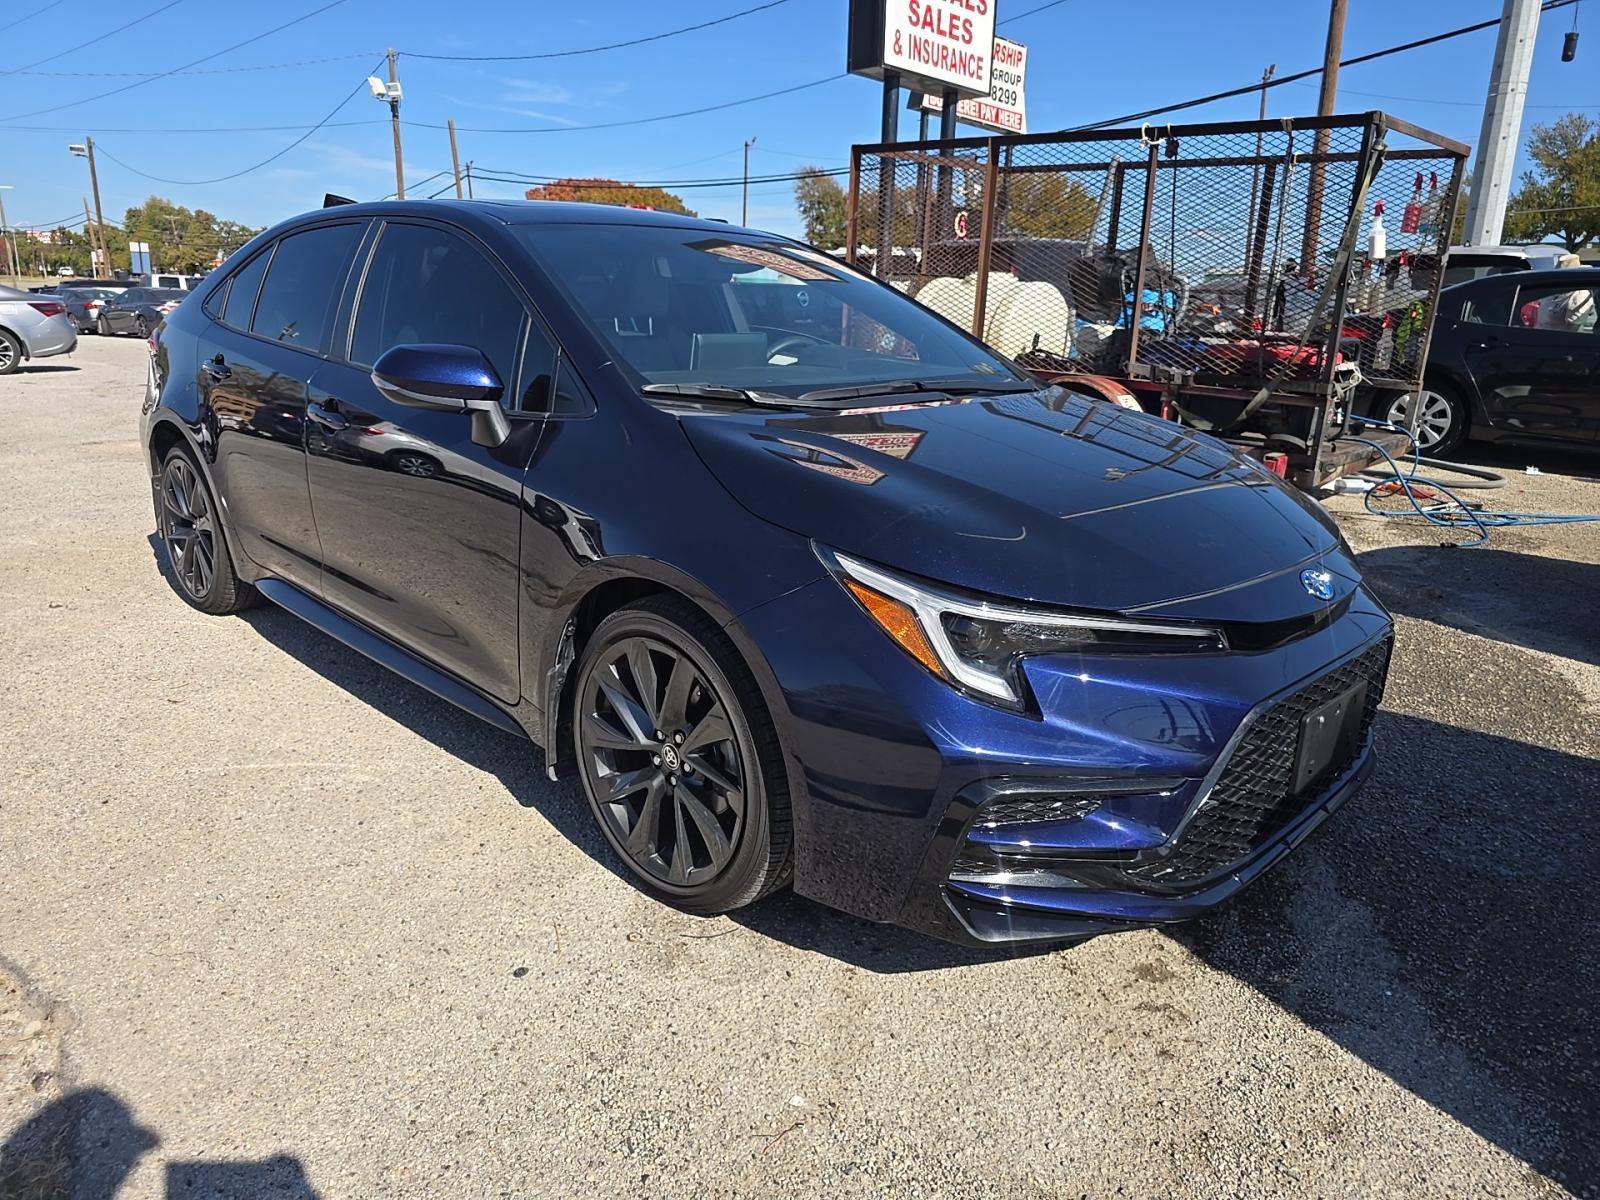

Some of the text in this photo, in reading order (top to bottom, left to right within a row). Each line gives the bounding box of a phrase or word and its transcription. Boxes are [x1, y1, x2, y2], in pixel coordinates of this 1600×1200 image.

[908, 0, 973, 45] SALES
[893, 28, 984, 81] & INSURANCE
[992, 67, 1022, 86] GROUP
[991, 85, 1017, 106] 8299
[956, 99, 979, 119] ERE!
[980, 103, 997, 123] PAY
[998, 108, 1022, 130] HERE
